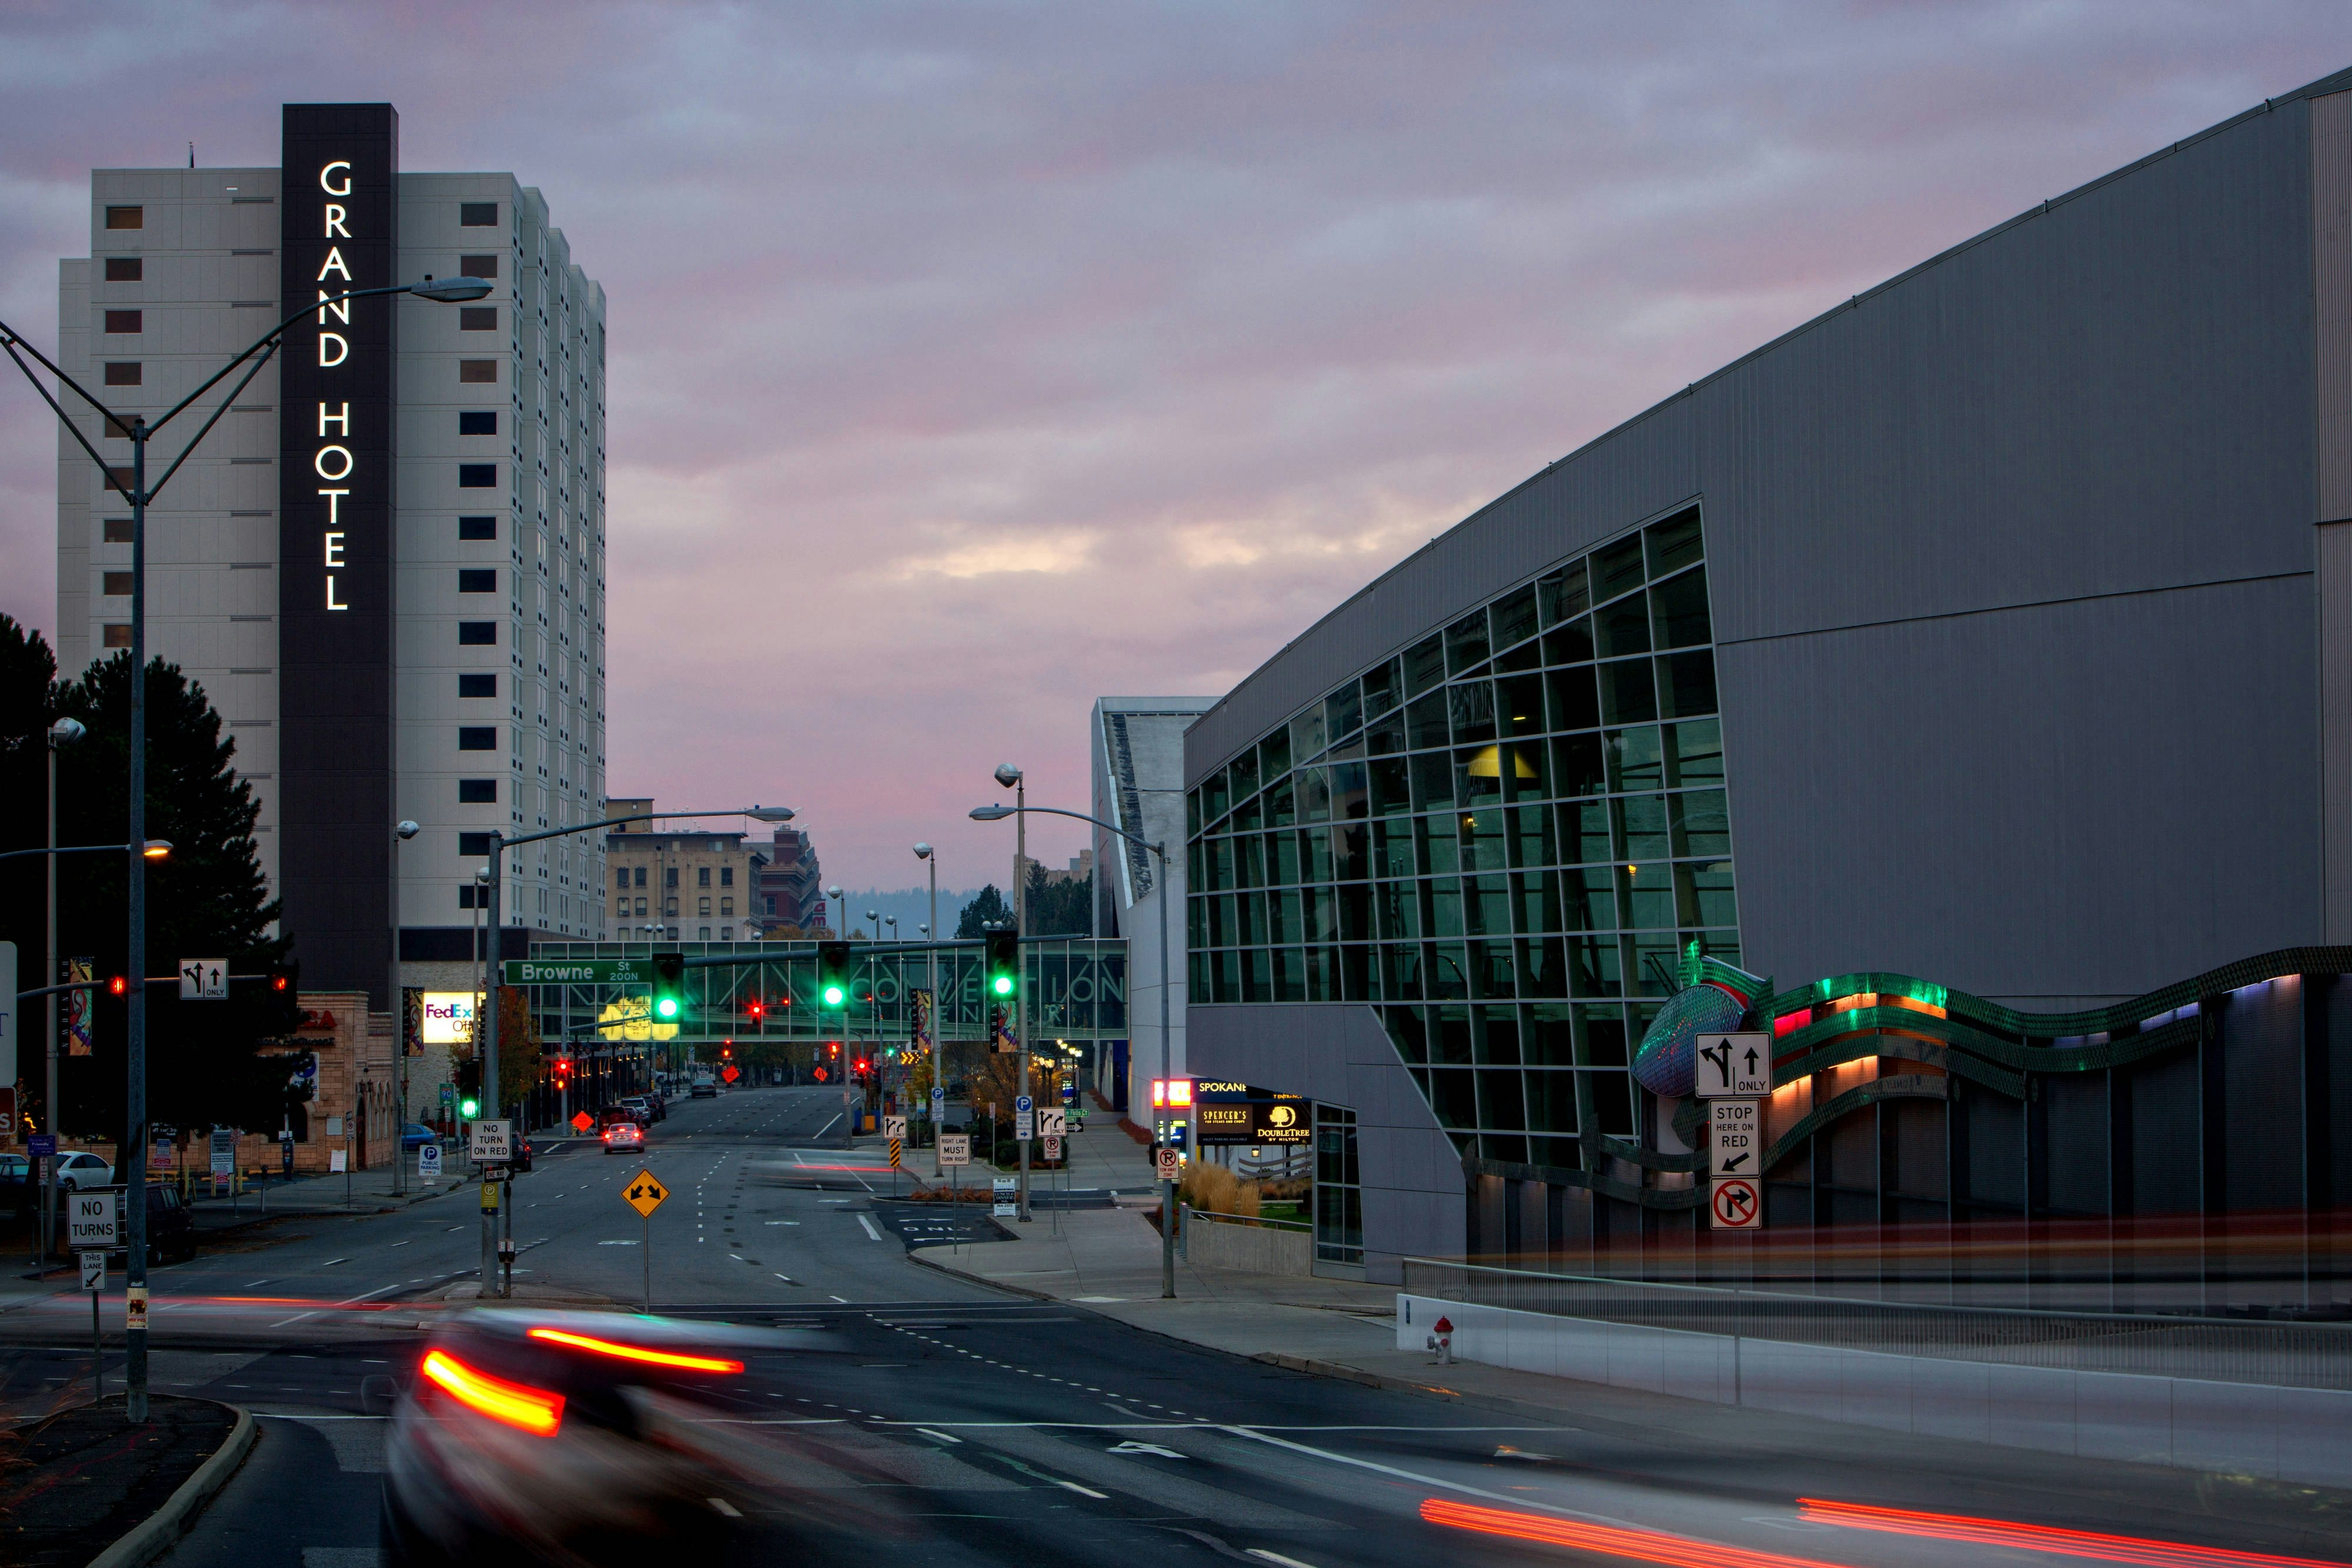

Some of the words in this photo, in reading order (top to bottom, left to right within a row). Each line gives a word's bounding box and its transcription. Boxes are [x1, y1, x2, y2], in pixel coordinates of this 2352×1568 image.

[318, 161, 352, 367] GRAND
[315, 402, 353, 611] HOTEL
[617, 961, 630, 971] St
[522, 964, 594, 980] Browne
[610, 972, 638, 981] 200N
[426, 1004, 472, 1018] FedEx
[1199, 1082, 1246, 1092] SPOKANE
[1739, 1081, 1766, 1091] ONLY
[1204, 1111, 1246, 1120] SPENCER'S
[1718, 1108, 1752, 1119] STOP
[1722, 1136, 1748, 1147] RED
[82, 1202, 102, 1215] NO
[72, 1223, 113, 1236] TURNS
